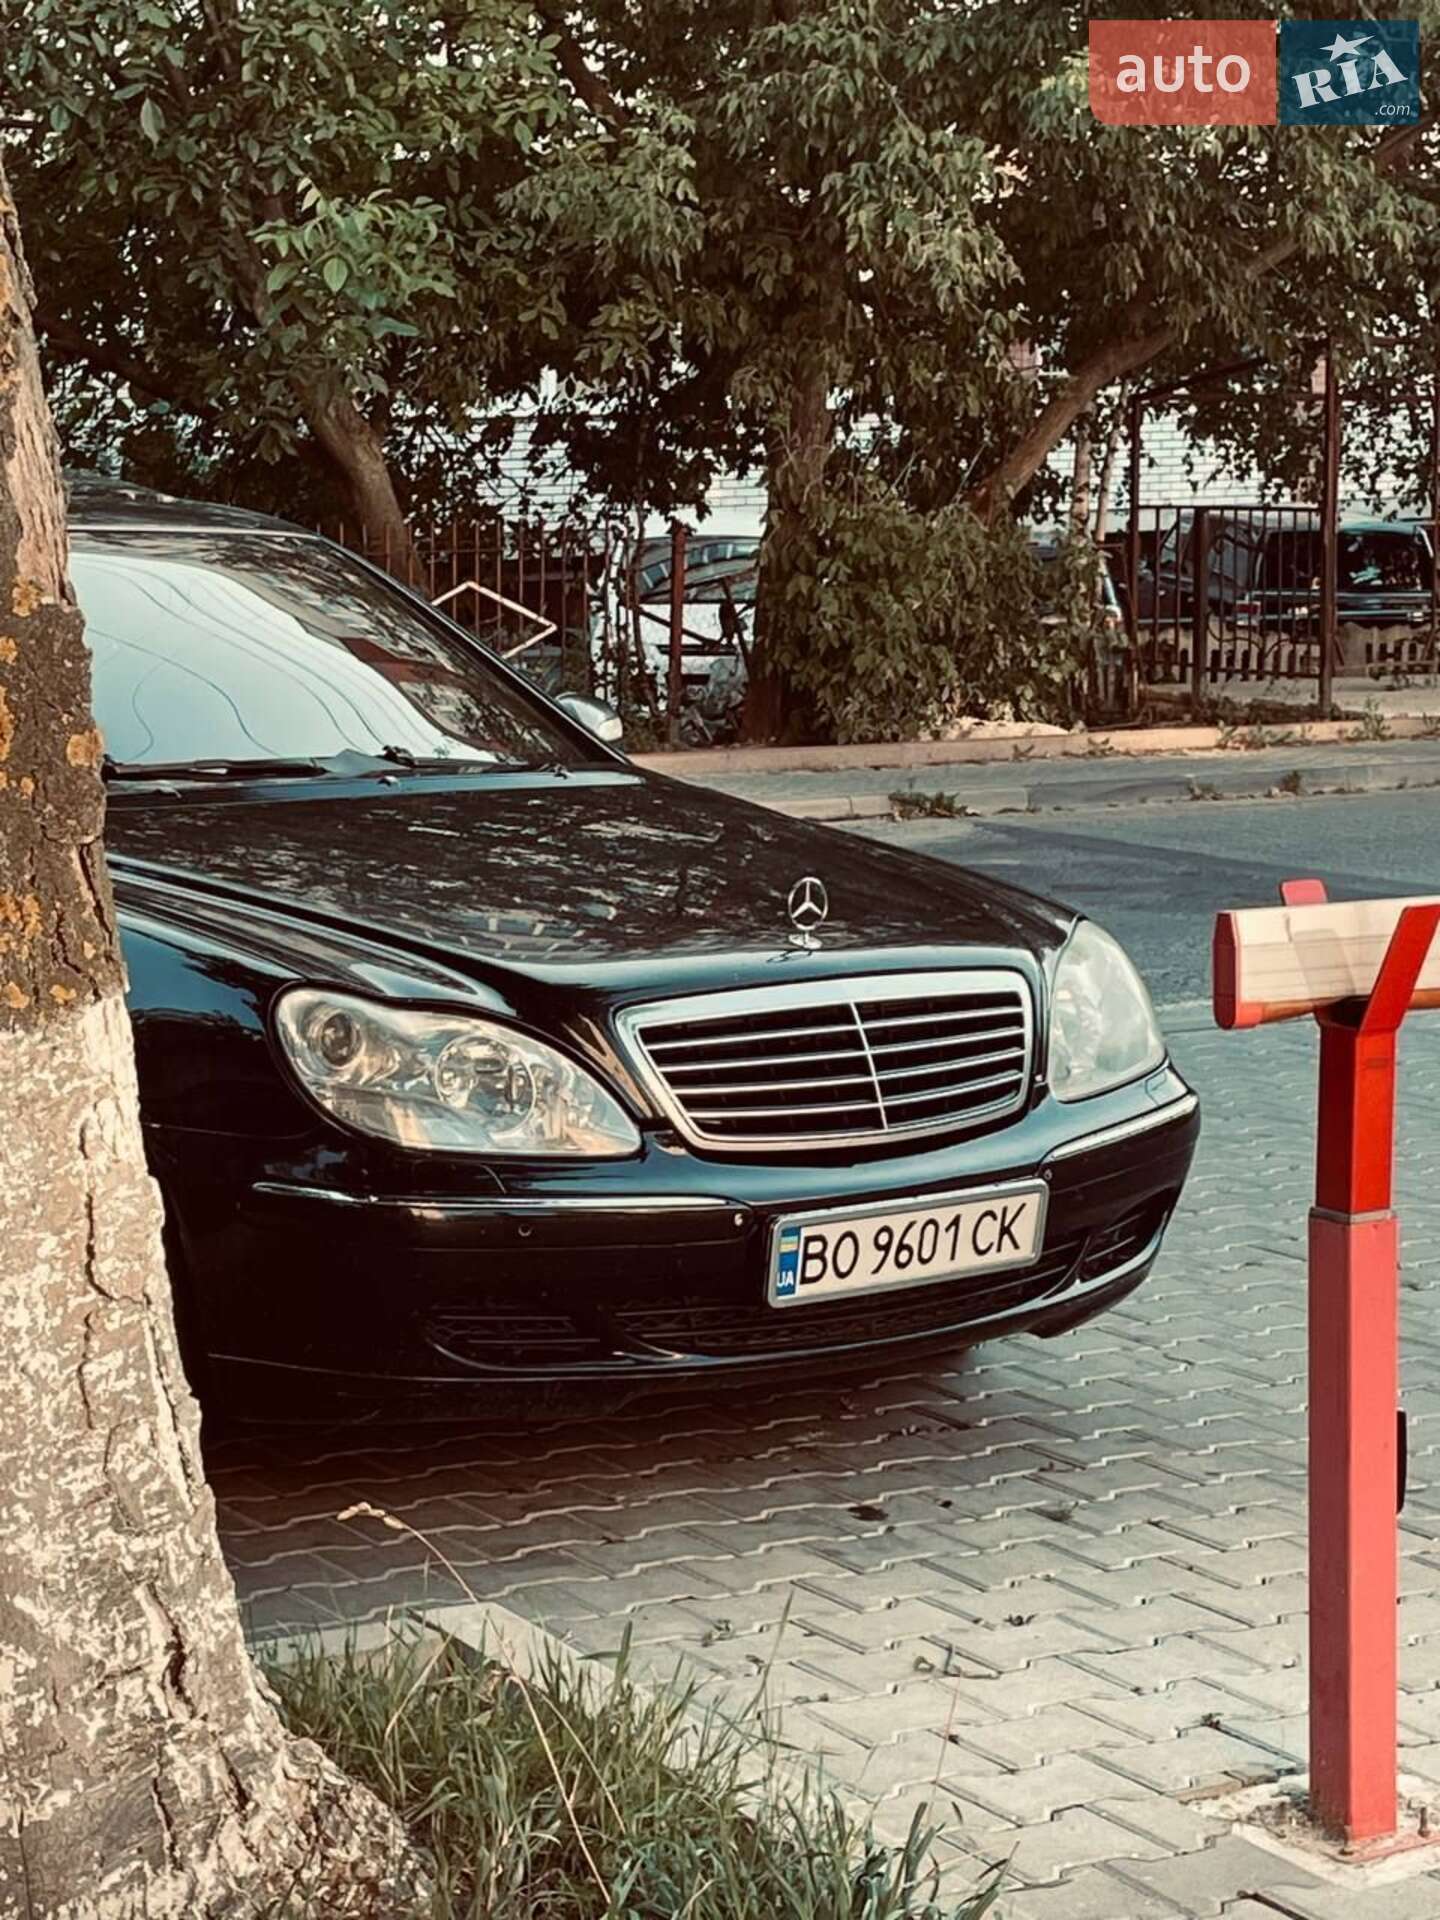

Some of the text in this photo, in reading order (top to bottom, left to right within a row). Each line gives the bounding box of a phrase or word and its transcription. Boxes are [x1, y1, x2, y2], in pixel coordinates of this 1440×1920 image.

[799, 1202, 1027, 1285] BO 9601 CK
[776, 1270, 794, 1287] UA
